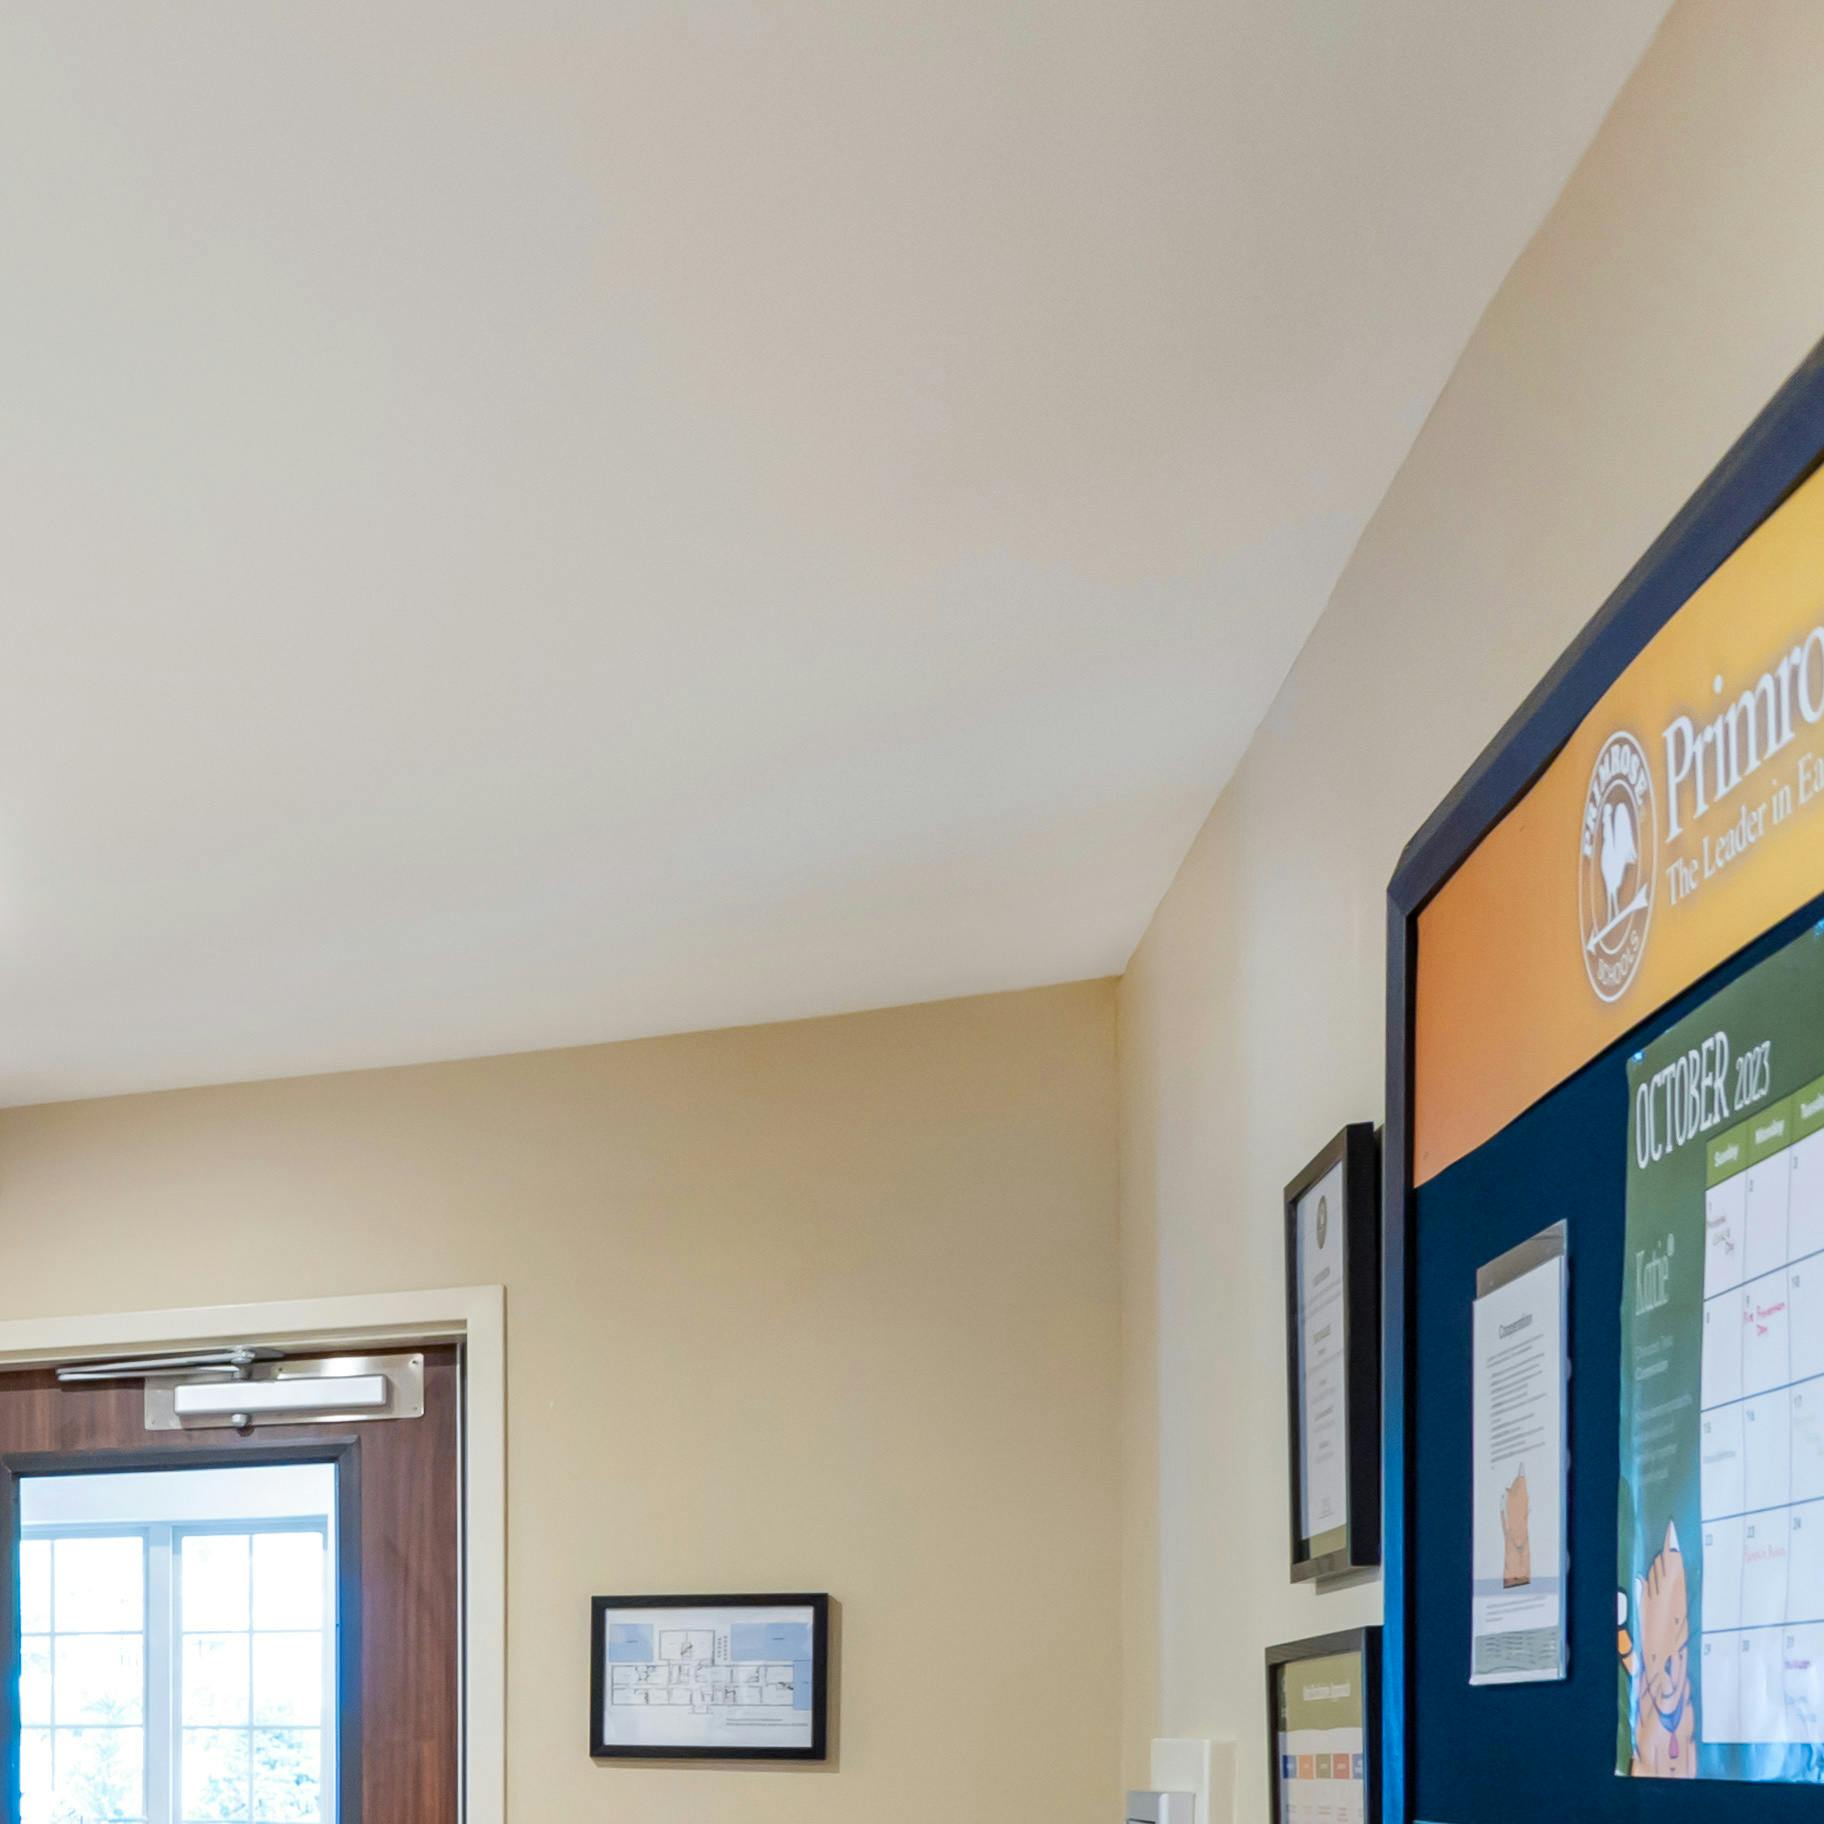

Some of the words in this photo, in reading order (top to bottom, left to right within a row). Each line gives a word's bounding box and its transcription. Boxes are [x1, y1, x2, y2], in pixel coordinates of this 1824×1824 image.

[1583, 743, 1648, 859] PRIMROSE
[1666, 856, 1699, 906] The
[1701, 803, 1768, 880] Leader
[1771, 779, 1793, 825] in
[1636, 1030, 1729, 1170] OCTOBER
[1734, 1040, 1772, 1111] 2023
